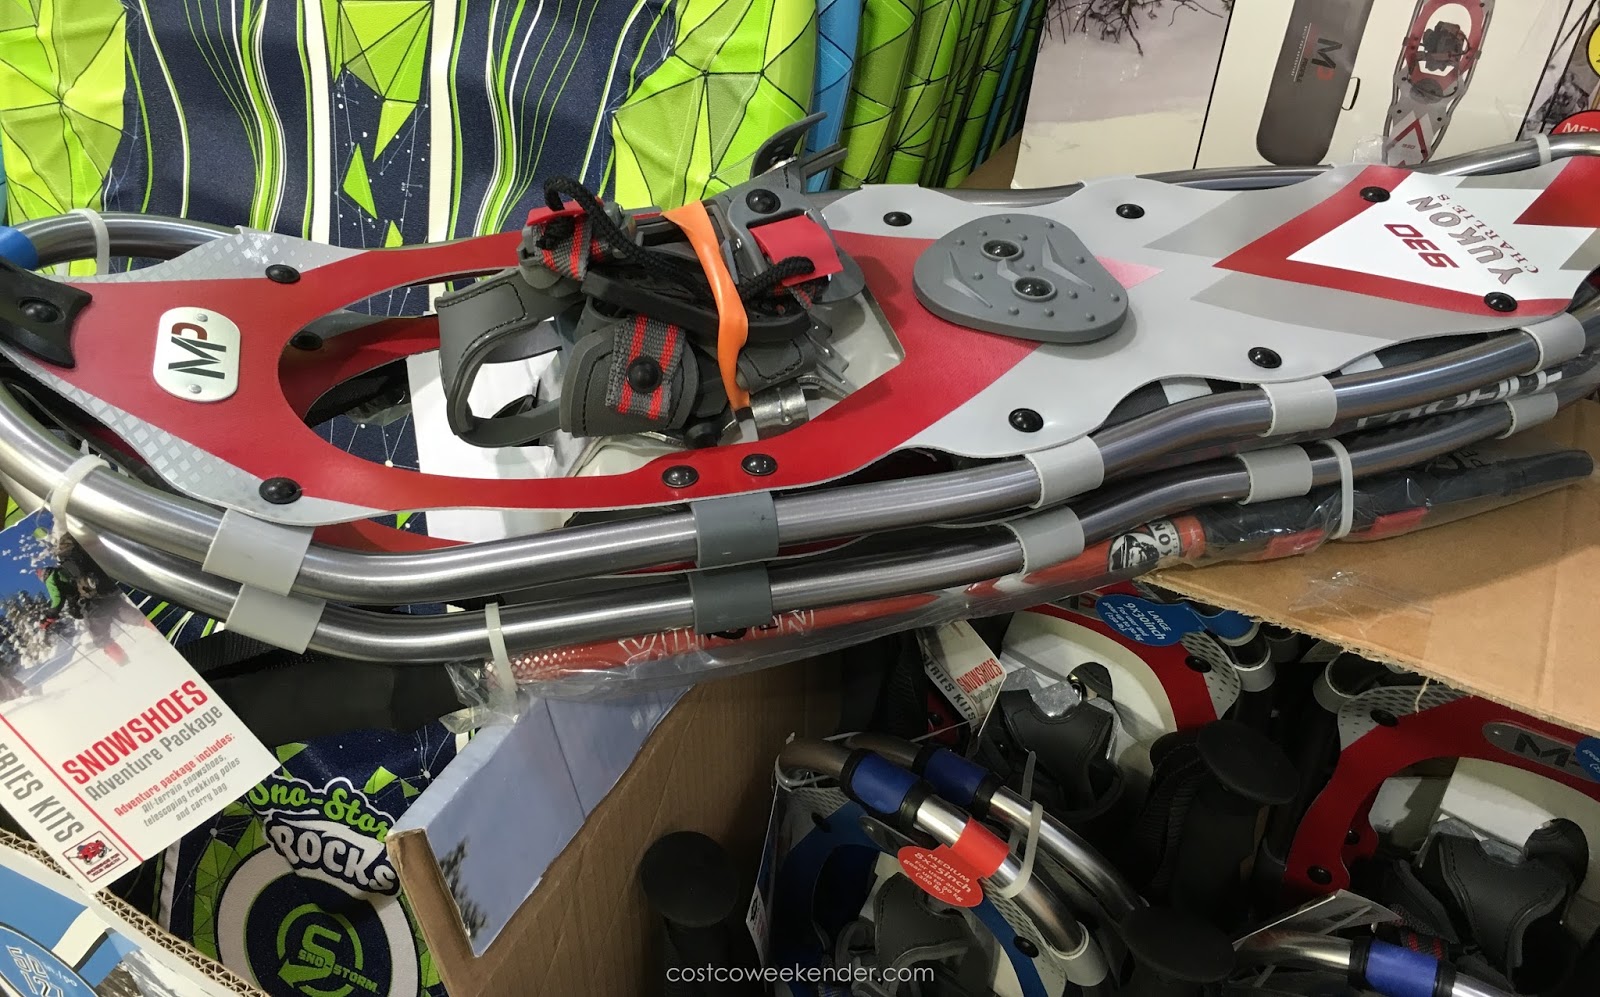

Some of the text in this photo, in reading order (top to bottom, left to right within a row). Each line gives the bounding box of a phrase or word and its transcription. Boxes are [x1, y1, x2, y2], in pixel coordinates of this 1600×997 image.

[1383, 223, 1460, 269] 930
[1406, 195, 1523, 285] YUKON
[1437, 193, 1539, 274] CHARLIE'S
[167, 321, 227, 380] MP
[1125, 614, 1139, 627] user
[1136, 626, 1150, 637] and
[1147, 610, 1172, 632] LARGE
[922, 652, 955, 692] SERIES
[956, 658, 1003, 694] SNOWSHOES
[953, 693, 976, 720] KITS
[61, 680, 208, 785] SNOWSHOES
[84, 705, 223, 801] Adventure Package
[113, 732, 236, 816] Adventure package includes:
[141, 753, 227, 814] All-terrain snowshoes,
[143, 757, 241, 828] telescoping trekking poles
[28, 795, 85, 843] KITS
[175, 782, 228, 822] and carry bag
[249, 782, 389, 844] Sno-Stor
[269, 824, 397, 891] ROCKS
[903, 859, 922, 872] gear
[921, 871, 933, 880] up
[933, 878, 942, 886] to
[914, 860, 961, 894] For user and
[927, 853, 970, 883] MEDIUM
[297, 949, 379, 993] SNO-STORM
